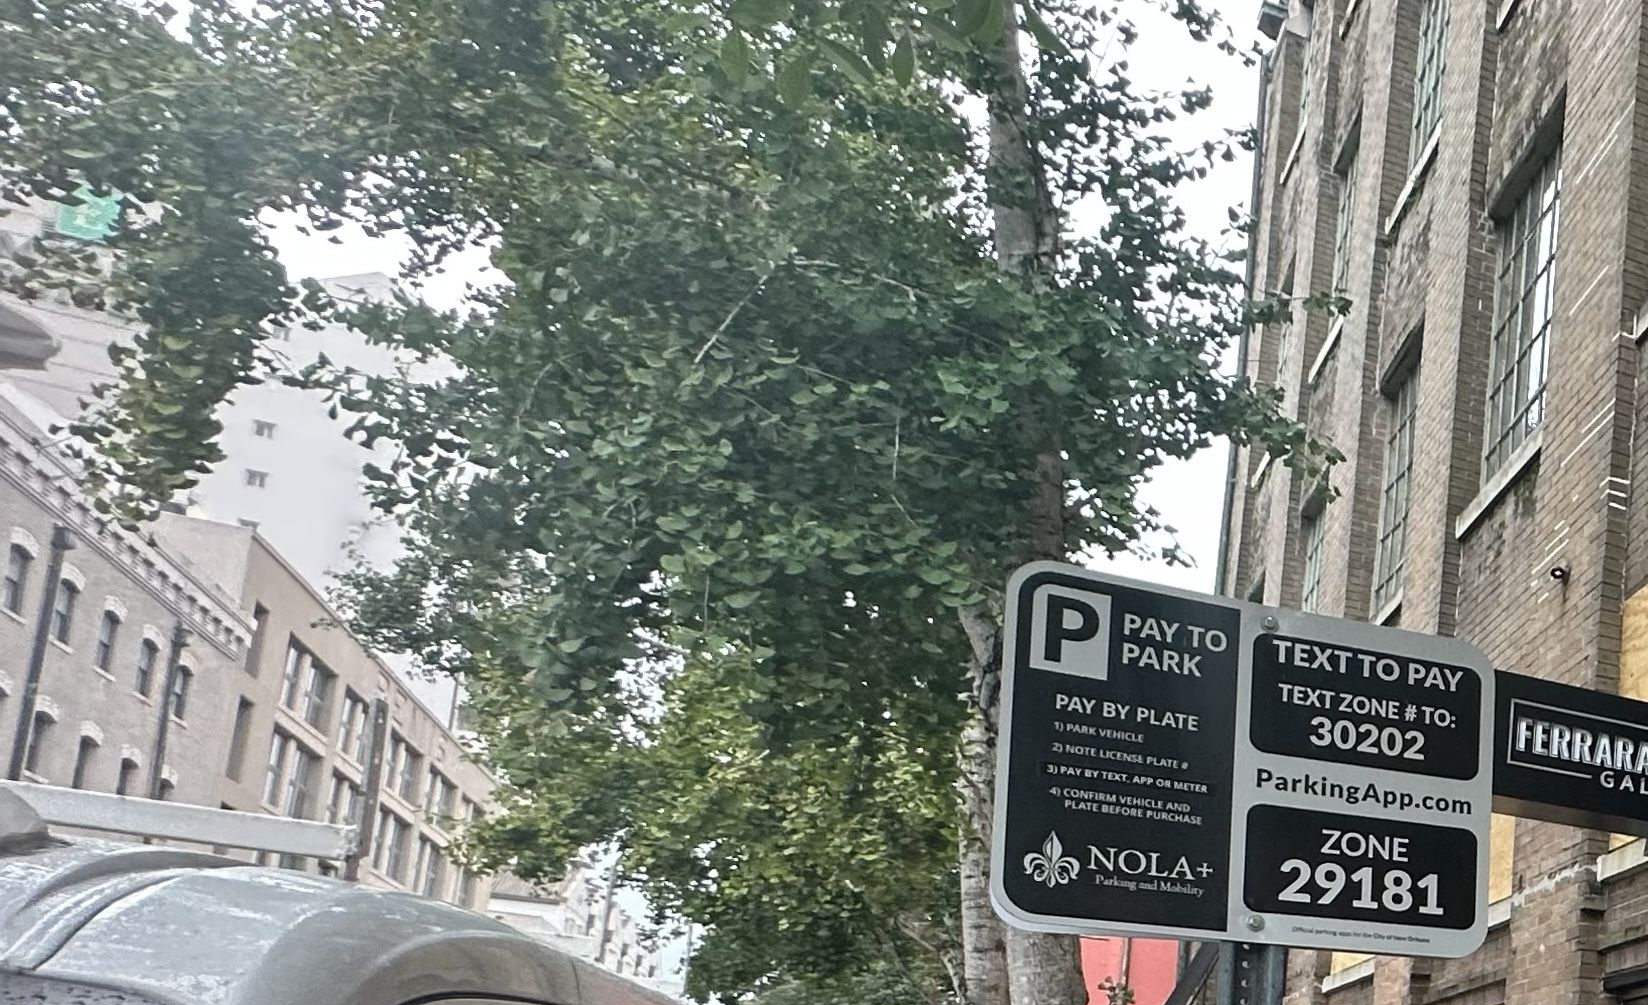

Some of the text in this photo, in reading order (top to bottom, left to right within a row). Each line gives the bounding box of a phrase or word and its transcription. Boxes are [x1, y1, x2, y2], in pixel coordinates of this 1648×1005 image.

[1044, 593, 1100, 663] P
[1123, 612, 1228, 652] PAY TO
[1121, 642, 1203, 677] PARK
[1272, 639, 1464, 692] TEXT TO PAY
[1055, 693, 1200, 732] PAY BY PLATE
[1278, 683, 1457, 729] TEXT ZONE # TO:
[1053, 721, 1145, 743] 1) PARK VEHICLE
[1309, 716, 1425, 761] 30202
[1051, 742, 1063, 753] 2)
[1065, 744, 1098, 757] NOTE
[1100, 749, 1144, 764] LICENSE
[1146, 757, 1179, 769] PLATE
[1046, 764, 1058, 775] 3)
[1060, 765, 1083, 777] PAY
[1084, 769, 1099, 778] BY
[1132, 774, 1154, 785] APP
[1156, 778, 1172, 788] OR
[1174, 781, 1208, 793] METER
[1256, 768, 1473, 815] ParkingApp.com
[1049, 787, 1191, 813] 4) CONFIRM VEHICLE AND
[1064, 799, 1203, 825] PLATE BEFORE PURCHASE
[1320, 828, 1410, 863] ZONE
[1095, 874, 1205, 898] Parking and Mobility
[1278, 858, 1444, 916] 29181
